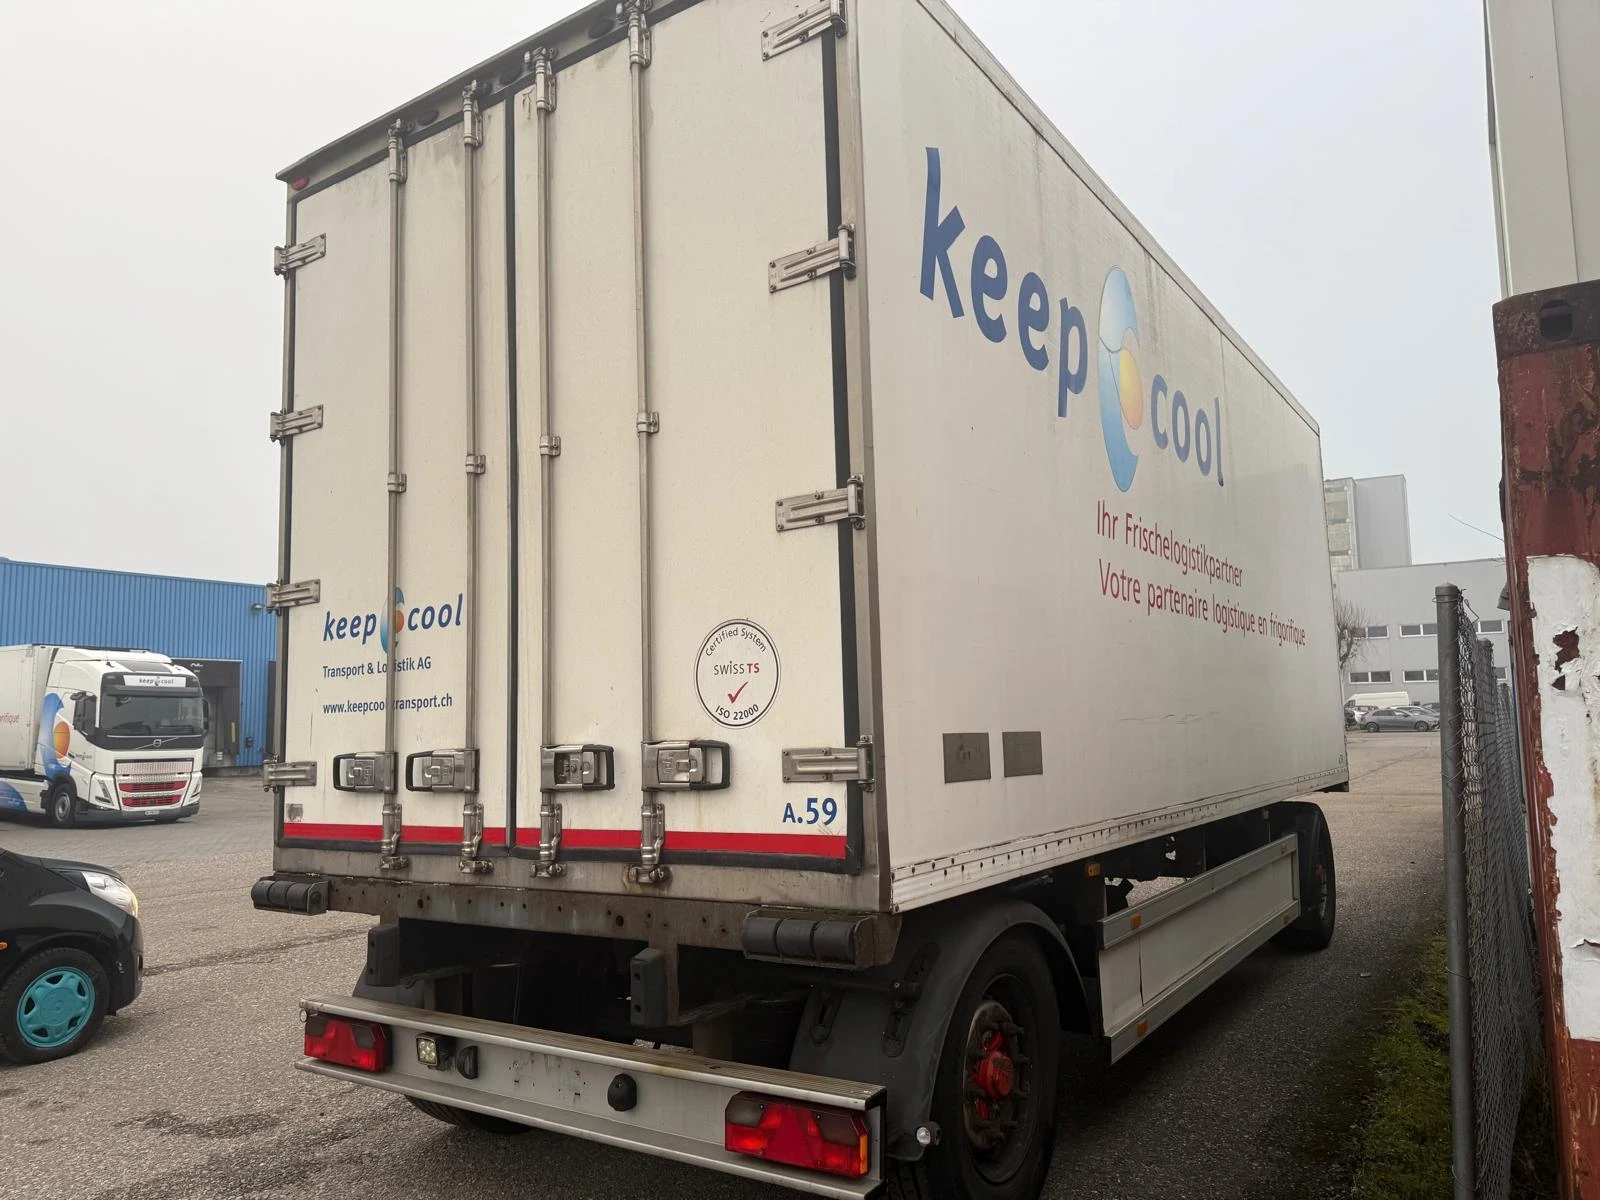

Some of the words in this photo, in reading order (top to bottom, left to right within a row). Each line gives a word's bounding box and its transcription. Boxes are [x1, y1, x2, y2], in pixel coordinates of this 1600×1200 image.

[919, 146, 1088, 418] keep
[1150, 373, 1224, 488] cool
[1097, 499, 1119, 541] Ihr
[1125, 512, 1243, 588] Frischelogistikpartner
[323, 610, 377, 645] keep
[407, 592, 464, 631] cool
[1099, 558, 1141, 605] Votre
[1147, 582, 1209, 621] partenaire
[1212, 594, 1256, 638] logistique
[1258, 615, 1268, 636] en
[1270, 612, 1306, 651] frigorifique
[705, 627, 739, 657] Certified
[740, 627, 767, 653] System
[323, 662, 365, 680] Transport
[367, 662, 375, 675] &
[377, 657, 415, 674] Loistik
[417, 656, 432, 670] AG
[713, 660, 745, 676] swiss
[746, 662, 760, 674] TS
[715, 705, 731, 719] ISO
[733, 703, 759, 721] 22000
[782, 797, 838, 826] A.59
